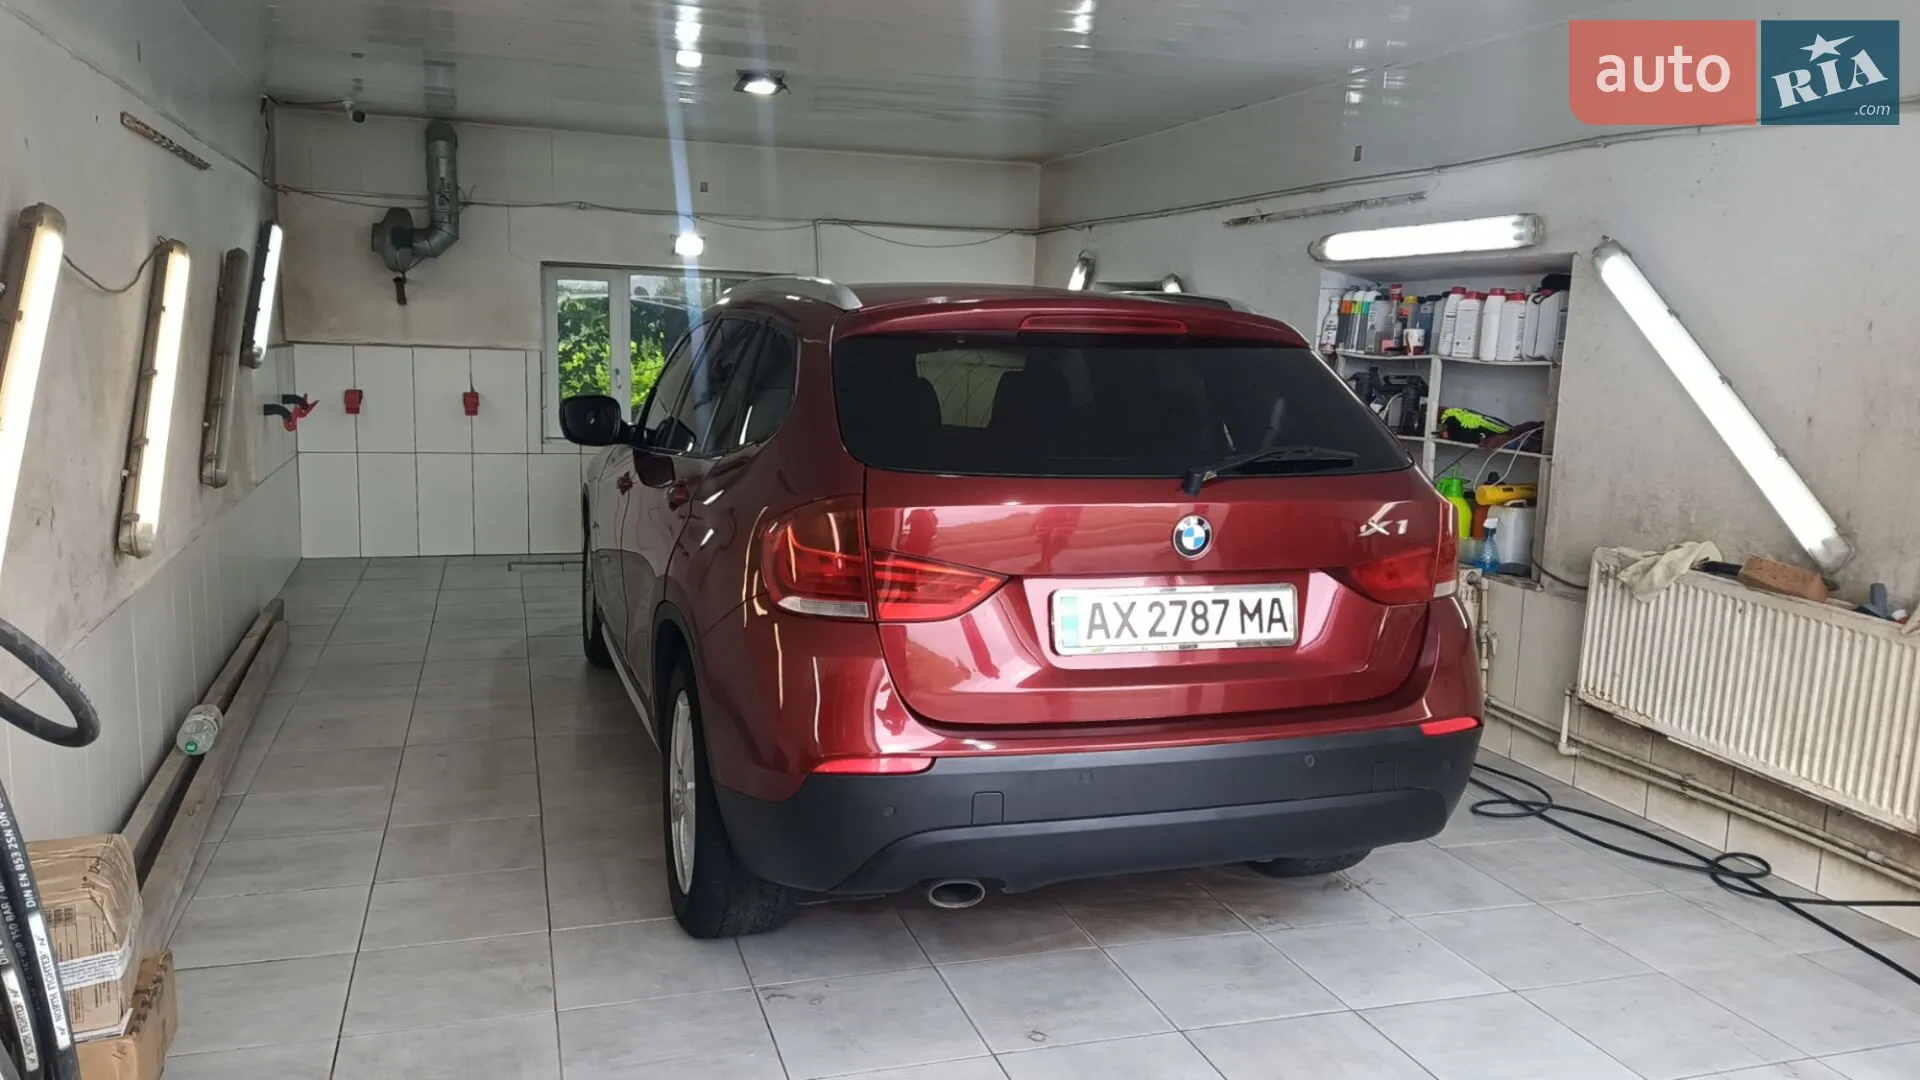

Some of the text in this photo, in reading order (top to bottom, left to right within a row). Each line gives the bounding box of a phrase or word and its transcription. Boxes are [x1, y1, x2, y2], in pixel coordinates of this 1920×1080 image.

[1086, 597, 1288, 640] AX 2787 MA
[3, 829, 19, 850] 2SN
[10, 851, 26, 871] 853
[18, 872, 31, 888] EN
[22, 889, 37, 909] DIN
[0, 902, 16, 922] BAR
[39, 953, 63, 1022] NORTH FIGHTER
